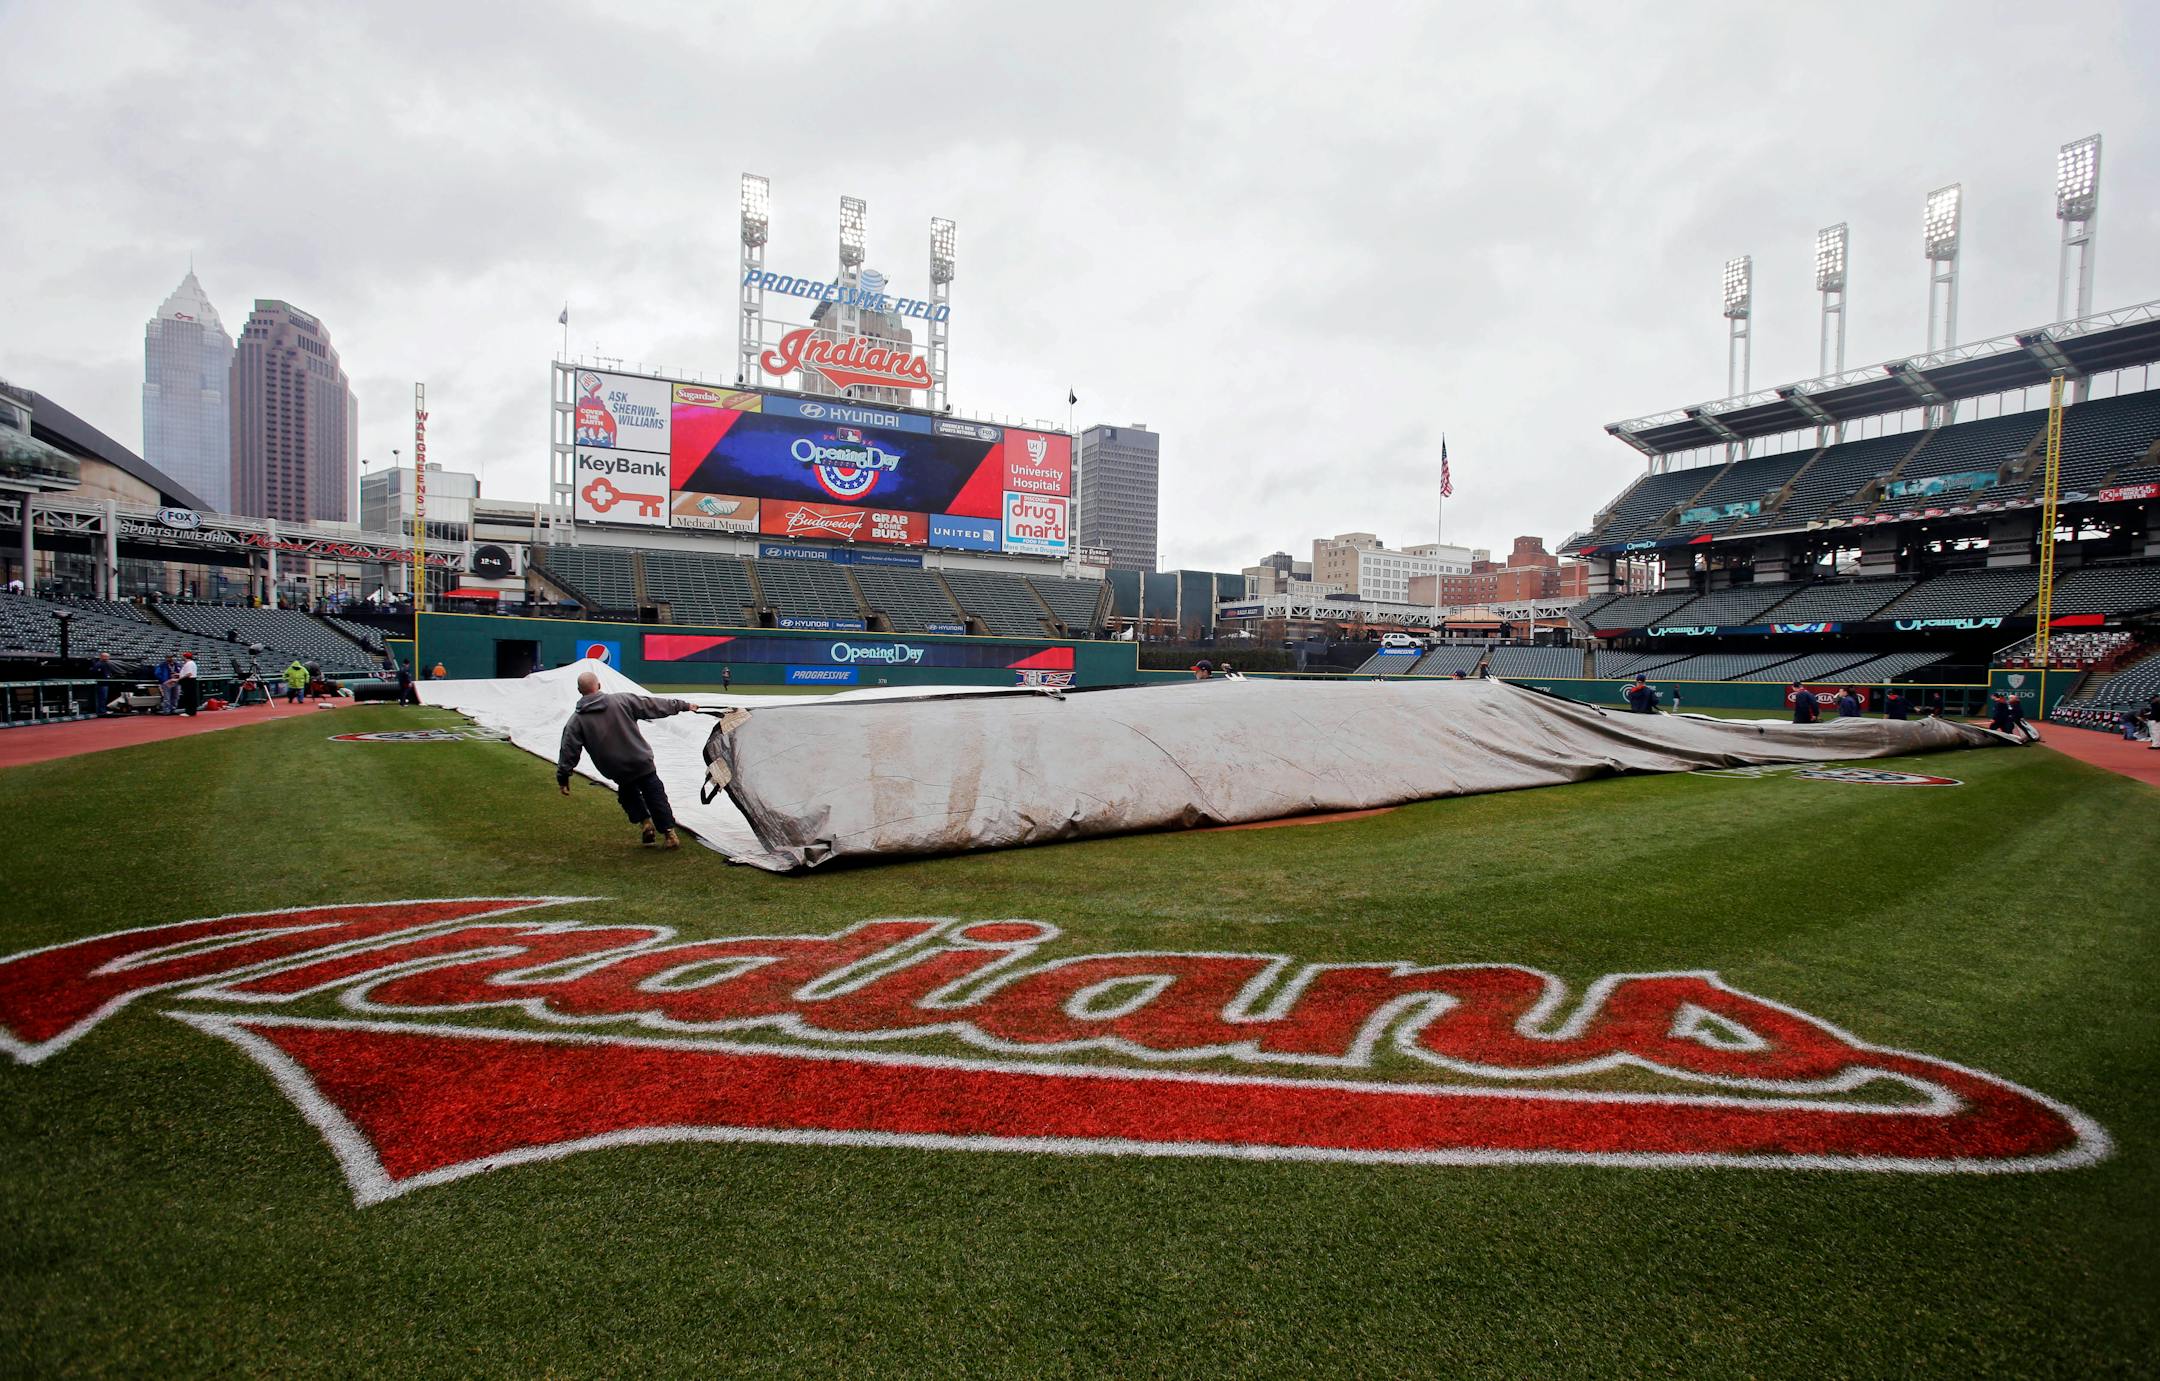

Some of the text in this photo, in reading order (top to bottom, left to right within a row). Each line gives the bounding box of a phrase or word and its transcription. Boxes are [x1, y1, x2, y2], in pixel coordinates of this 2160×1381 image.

[744, 269, 950, 322] PROGRESSIVE FIELD
[760, 328, 933, 390] Indians
[608, 391, 628, 402] ASK
[677, 388, 721, 403] Sugardale
[580, 408, 604, 416] COVER
[612, 403, 660, 418] SHERWIN-
[830, 407, 899, 428] HYUNDAI
[618, 415, 664, 429] WILLIAMS
[416, 411, 429, 504] WALGREENS
[790, 438, 901, 472] Opening Day
[579, 454, 666, 476] KeyBank
[1010, 464, 1063, 481] University
[1013, 477, 1061, 491] Hospitals
[167, 511, 192, 522] FOX
[1012, 495, 1056, 526] drug
[676, 517, 753, 531] Medical Mutual
[785, 511, 863, 529] Budweiser
[871, 512, 908, 525] GRAB
[871, 528, 908, 540] BUDS
[877, 522, 902, 531] SOME
[934, 527, 980, 539] UNITED
[1016, 523, 1062, 540] mart
[784, 549, 827, 559] HYUNDAI
[795, 620, 829, 628] HYUNDAI
[830, 642, 925, 663] Opening Day
[792, 670, 851, 680] PROGRESSIVE
[0, 896, 2100, 1180] Indians
